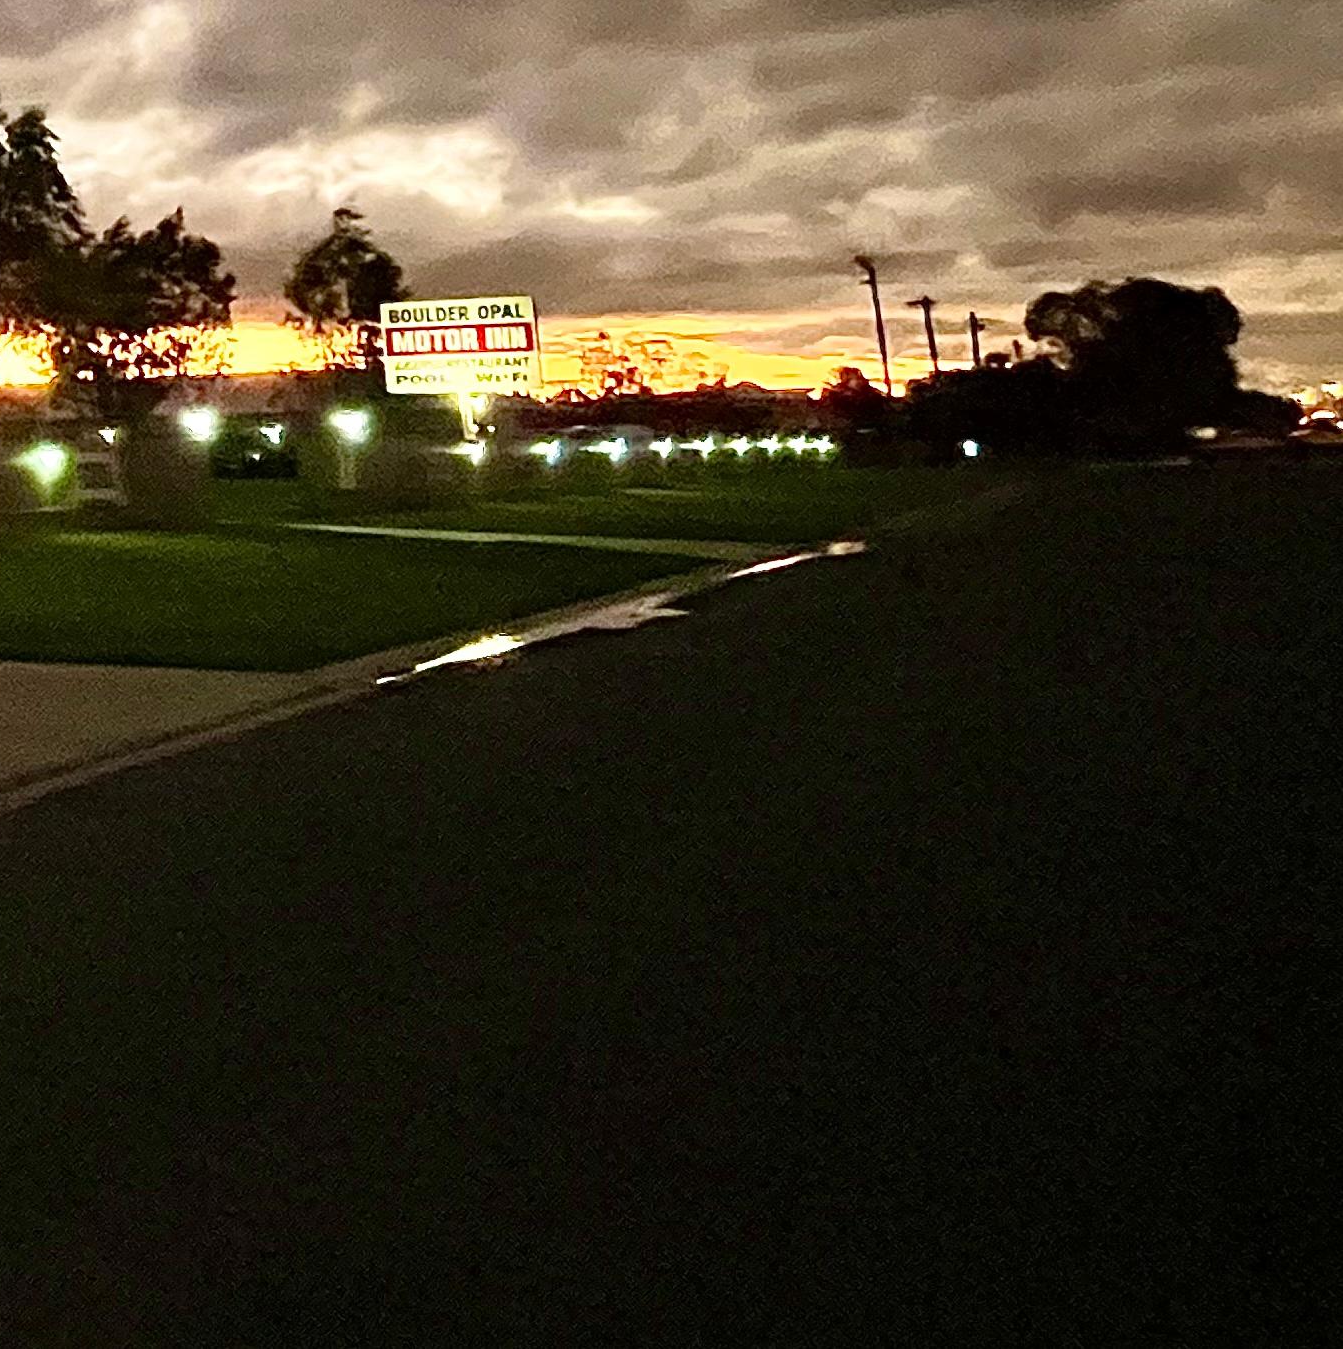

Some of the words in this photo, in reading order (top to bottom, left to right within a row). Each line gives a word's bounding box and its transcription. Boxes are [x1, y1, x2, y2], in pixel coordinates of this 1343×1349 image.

[388, 305, 470, 323] BOULDER
[477, 303, 525, 319] OPAL
[391, 327, 479, 353] MOTOR
[484, 325, 528, 350] INN
